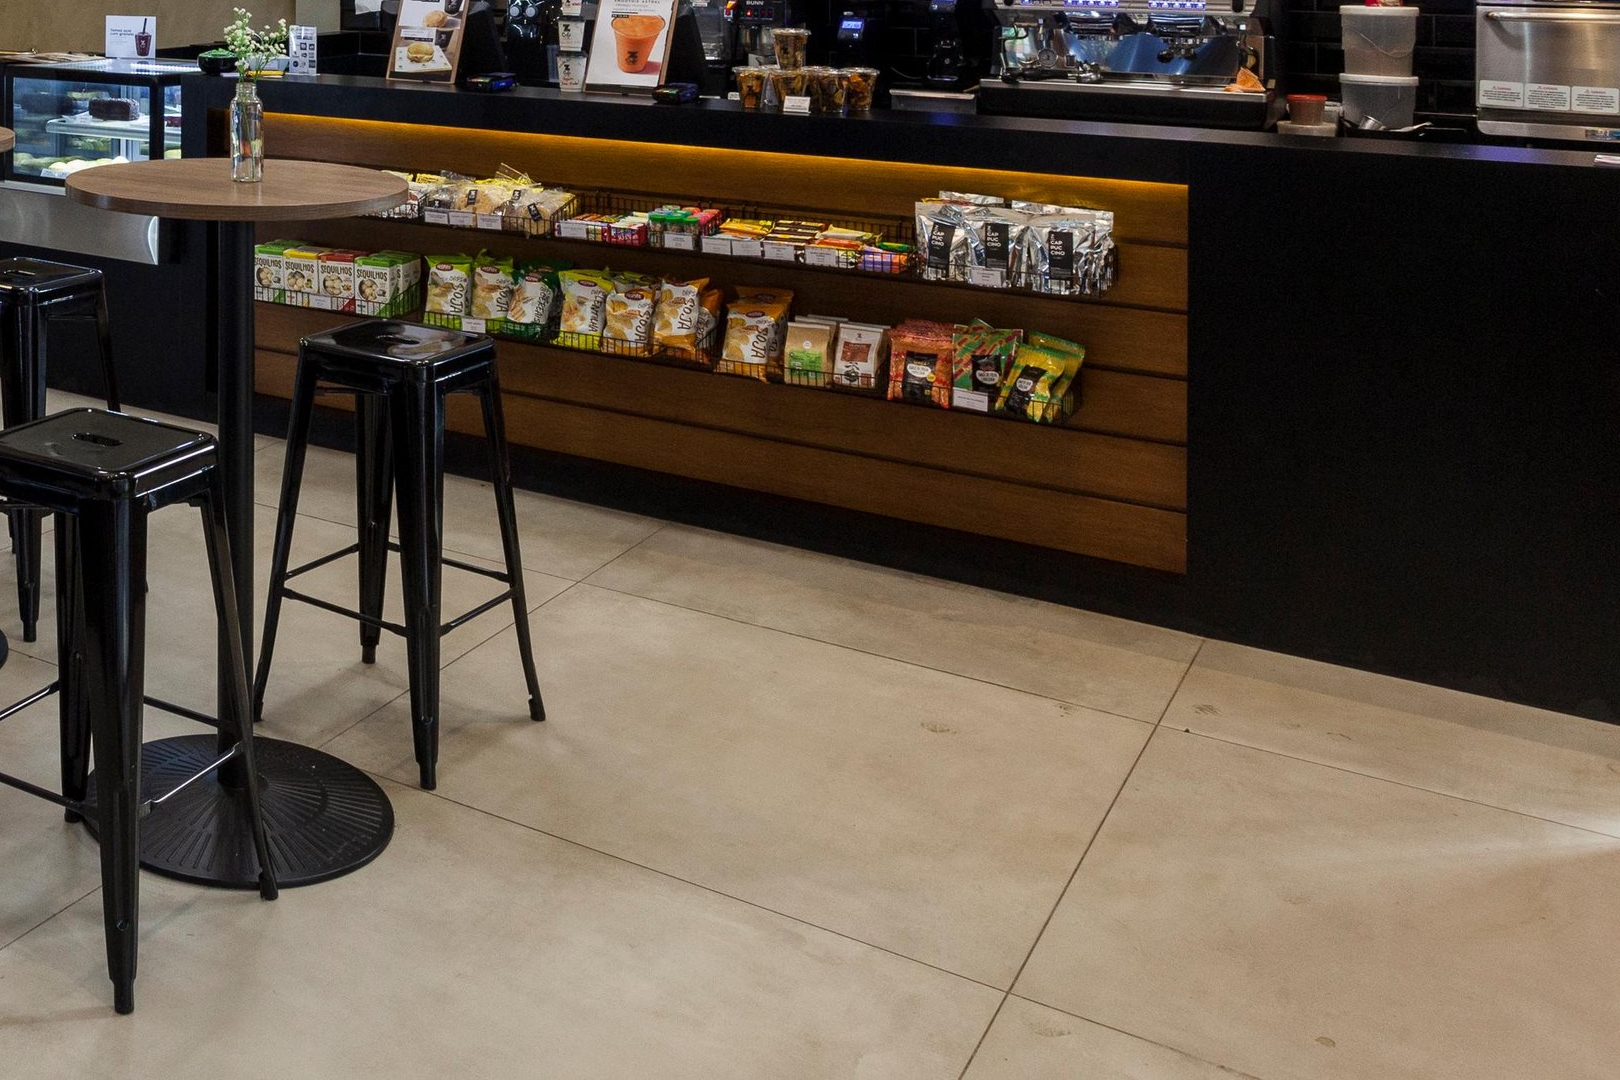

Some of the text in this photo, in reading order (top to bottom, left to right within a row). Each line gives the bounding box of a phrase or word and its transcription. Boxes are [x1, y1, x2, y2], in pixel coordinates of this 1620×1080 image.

[285, 261, 315, 274] SEQUILHOS
[320, 265, 353, 277] SEQUILHOS
[356, 268, 388, 282] SEQUILHOS
[450, 282, 465, 316] SOJA
[677, 298, 696, 330] SOJA
[750, 326, 769, 359] SOJA
